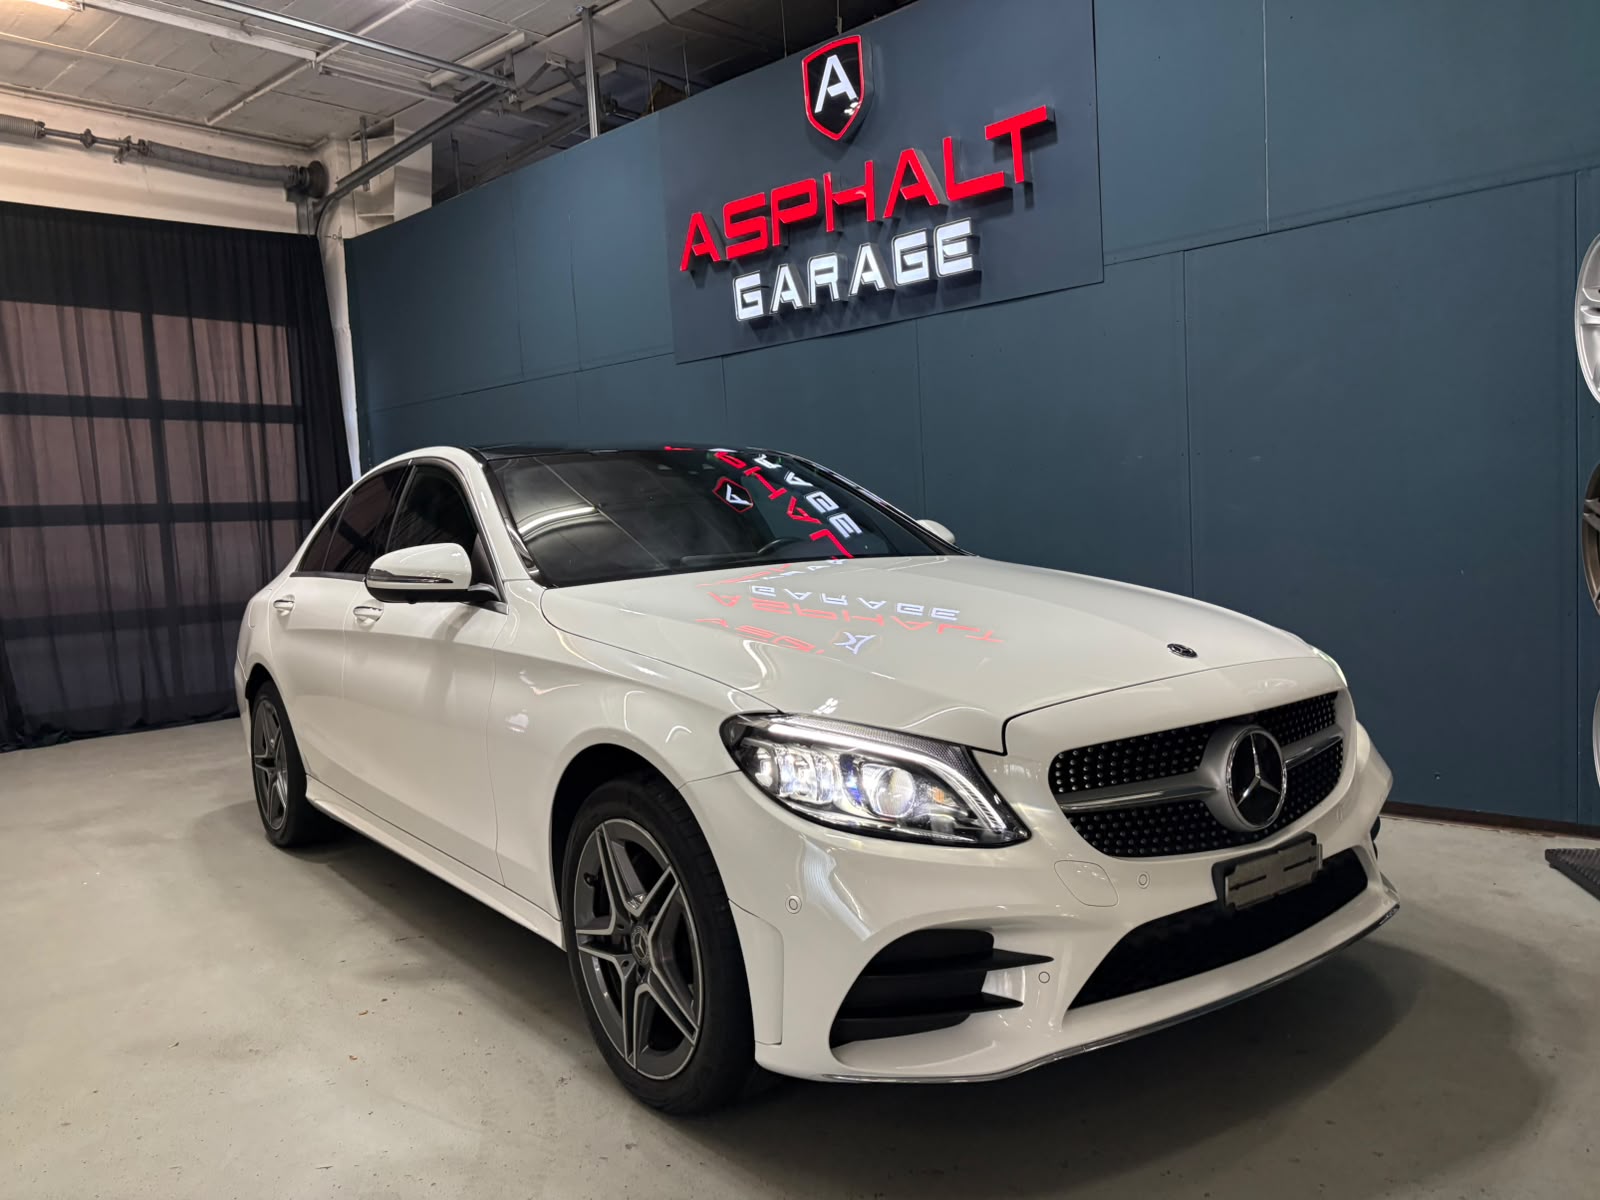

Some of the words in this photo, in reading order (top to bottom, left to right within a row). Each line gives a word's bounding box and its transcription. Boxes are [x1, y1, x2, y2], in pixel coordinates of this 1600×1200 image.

[814, 54, 859, 113] A
[680, 105, 1047, 271] ASPHALT
[732, 217, 975, 322] GARAGE
